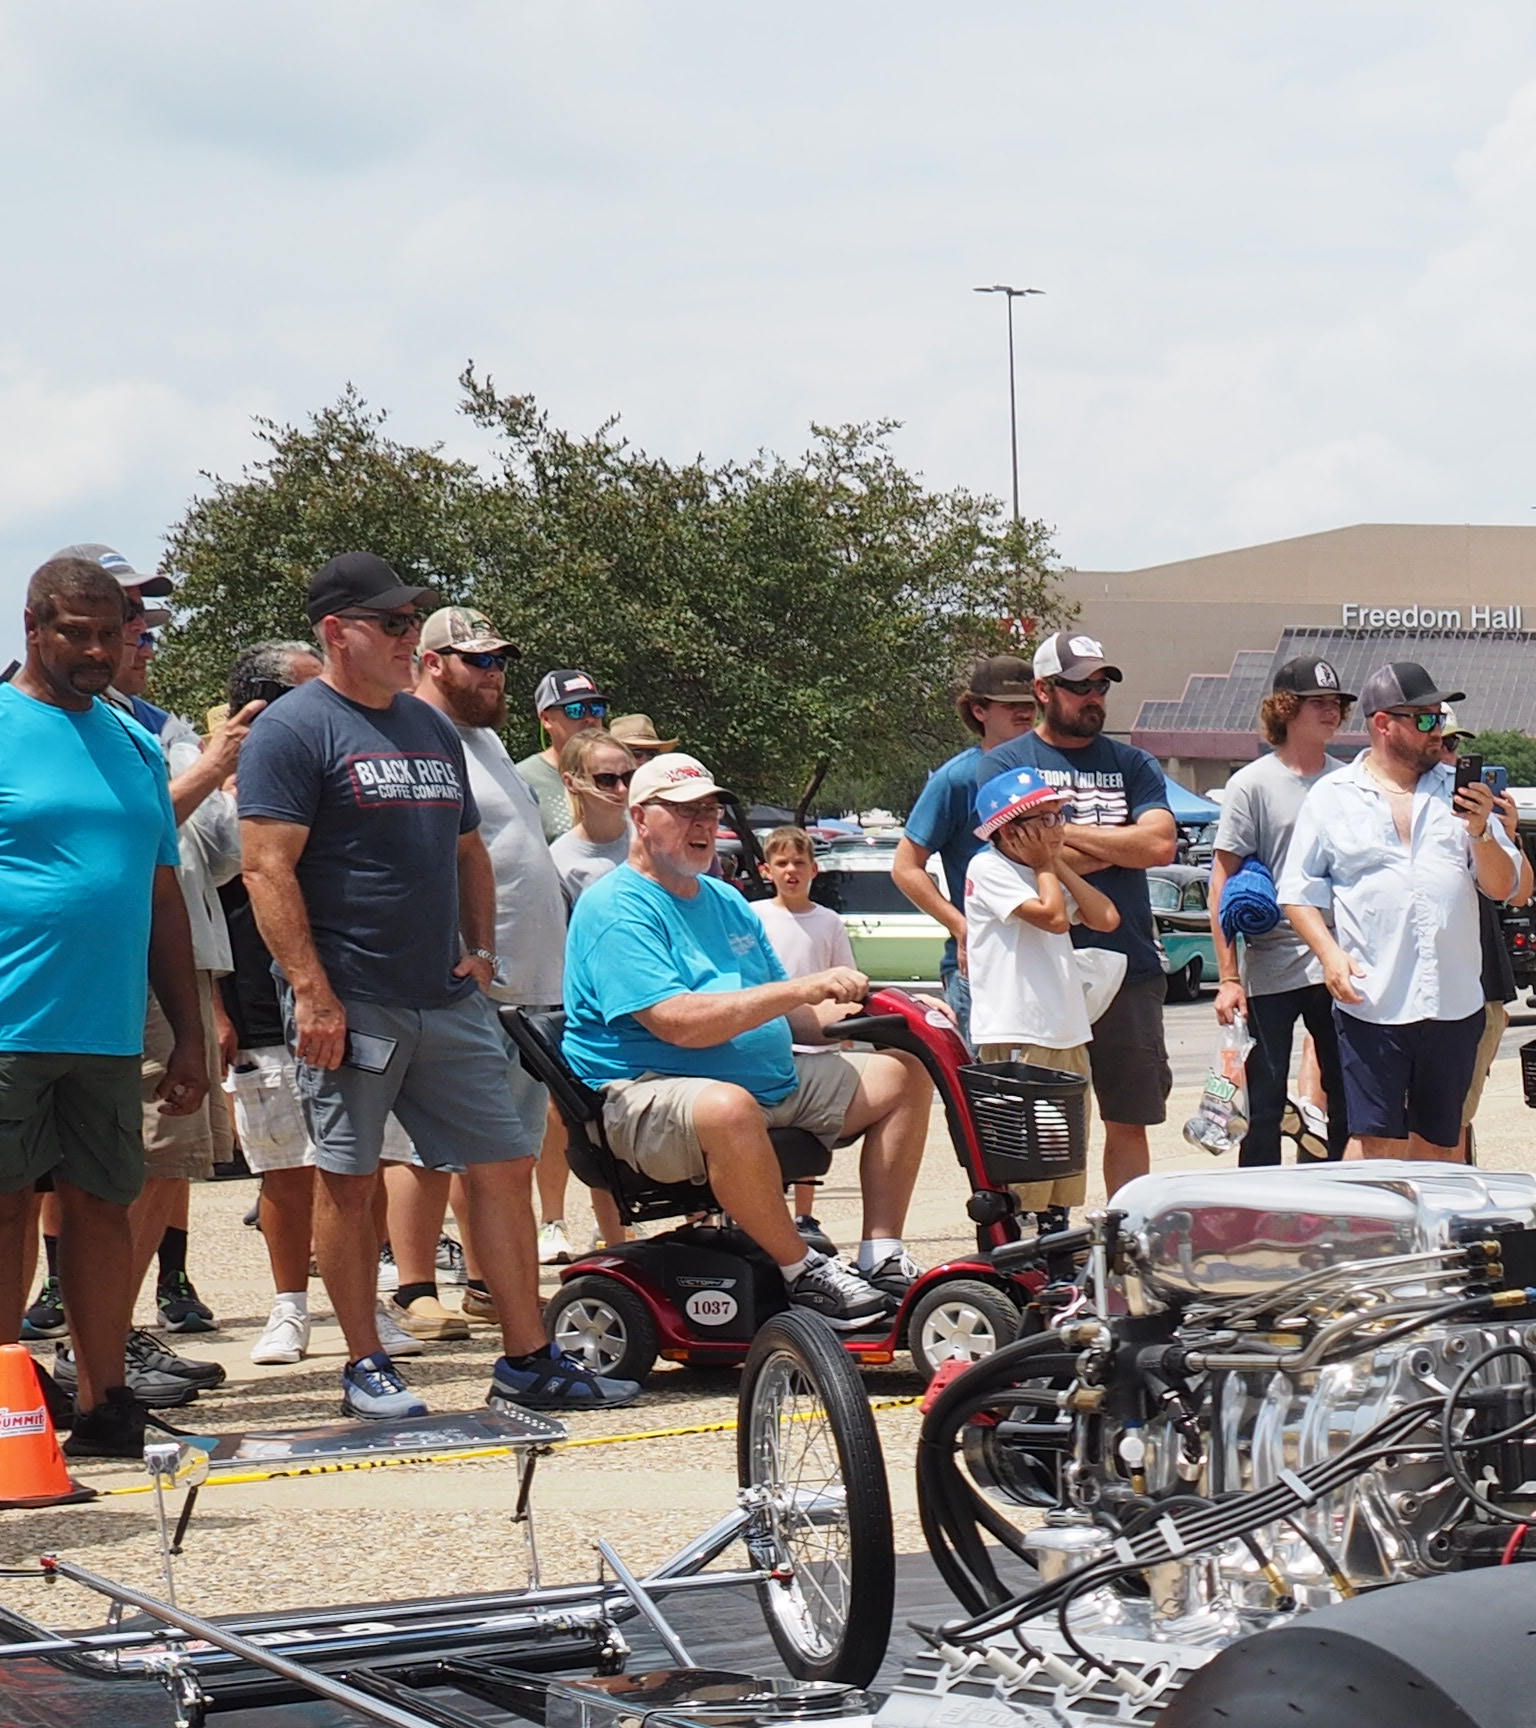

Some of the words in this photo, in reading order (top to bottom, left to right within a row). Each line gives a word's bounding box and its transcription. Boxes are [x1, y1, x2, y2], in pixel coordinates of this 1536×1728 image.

[1342, 603, 1461, 628] Freedom
[1471, 605, 1522, 629] Hall
[354, 760, 416, 785] BLACK
[413, 760, 460, 787] RIFLE
[1096, 770, 1124, 788] BEER
[378, 784, 412, 799] COFFEE
[412, 785, 460, 800] COMPANY
[692, 1301, 731, 1315] 1037
